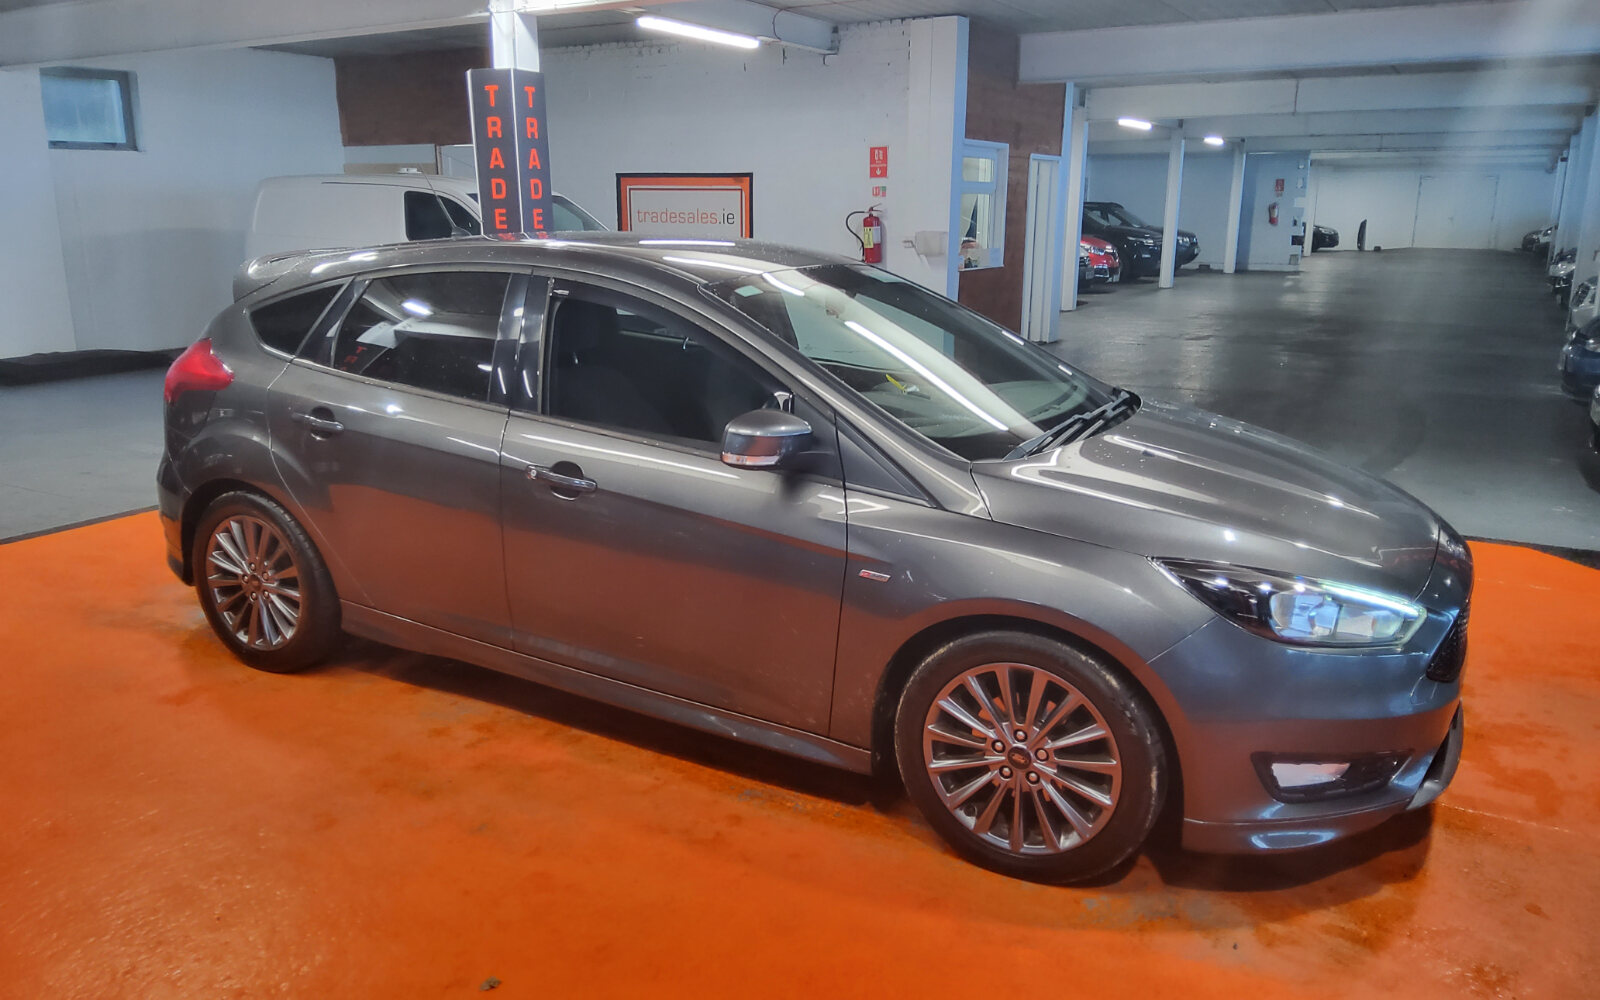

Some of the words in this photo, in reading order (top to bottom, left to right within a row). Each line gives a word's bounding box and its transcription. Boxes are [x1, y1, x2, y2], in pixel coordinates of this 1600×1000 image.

[484, 84, 508, 230] TRADE
[523, 86, 544, 230] TRADE
[637, 208, 735, 225] tradesales.ie
